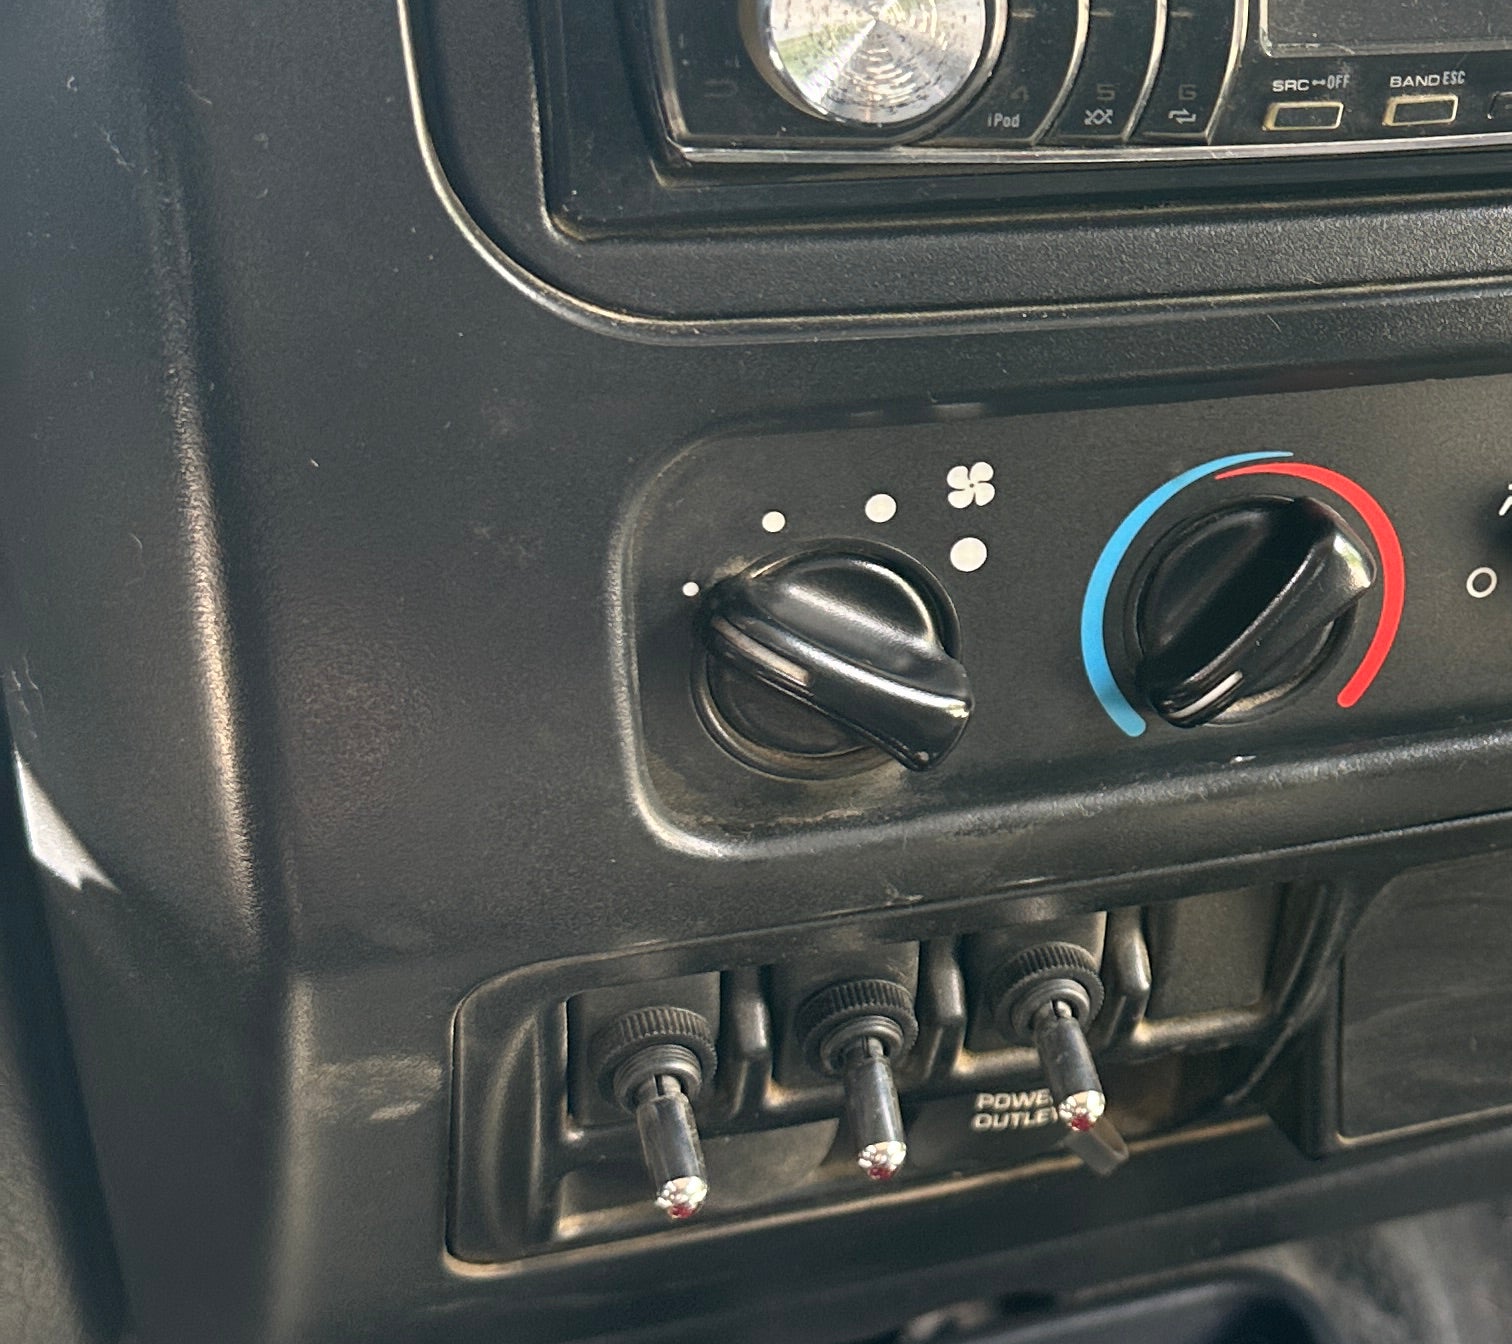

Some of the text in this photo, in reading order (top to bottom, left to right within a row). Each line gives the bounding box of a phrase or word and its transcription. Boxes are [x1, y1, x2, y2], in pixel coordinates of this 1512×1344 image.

[1272, 74, 1350, 93] SRC OFF
[1390, 70, 1467, 88] BAND ESC
[1010, 86, 1030, 101] 4
[1096, 84, 1116, 101] 5
[987, 112, 1021, 128] iPod
[974, 1088, 1054, 1110] POWE
